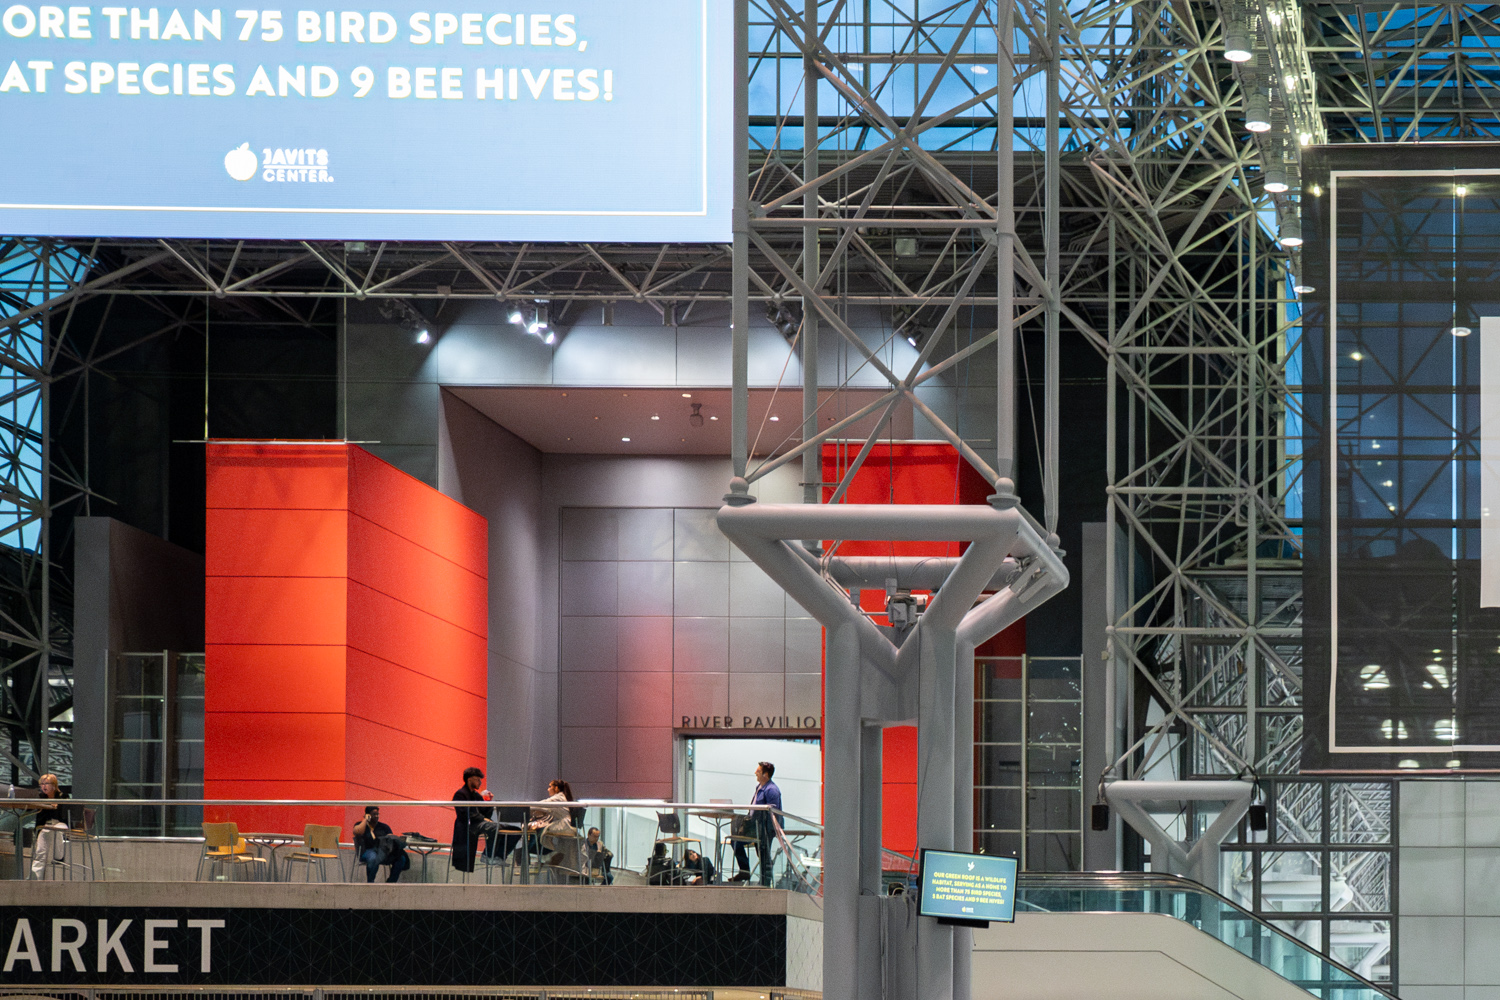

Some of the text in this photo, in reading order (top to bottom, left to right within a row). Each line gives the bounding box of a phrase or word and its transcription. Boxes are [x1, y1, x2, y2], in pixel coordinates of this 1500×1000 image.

[2, 5, 588, 52] ORE THAN 75 BIRD SPECIES,
[0, 60, 613, 101] AT SPECIES AND 9 BEE HIVES!
[262, 148, 328, 165] JAVITS
[682, 716, 822, 728] RIVER PAVILIO
[3, 918, 226, 973] ARKET
